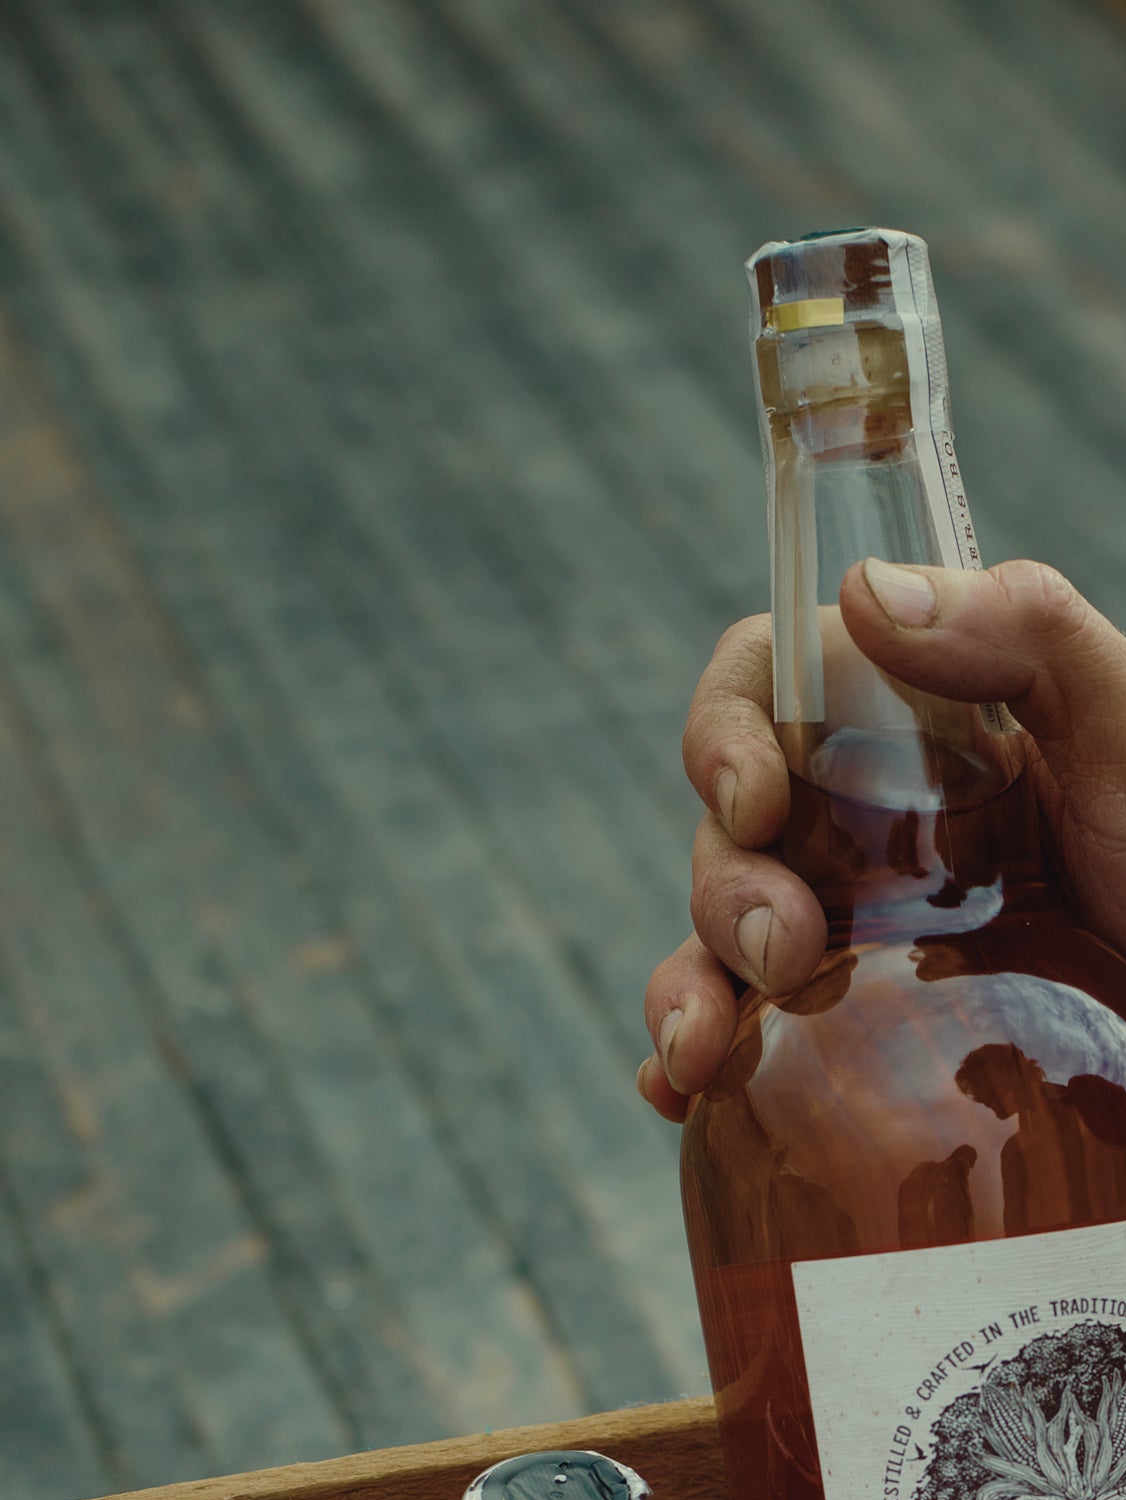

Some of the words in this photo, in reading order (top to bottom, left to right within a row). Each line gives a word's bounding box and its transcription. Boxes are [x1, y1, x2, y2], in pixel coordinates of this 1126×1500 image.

[910, 1406, 922, 1420] &
[920, 1341, 975, 1402] CRAFTED
[981, 1324, 1003, 1345] IN
[1008, 1306, 1041, 1331] THE
